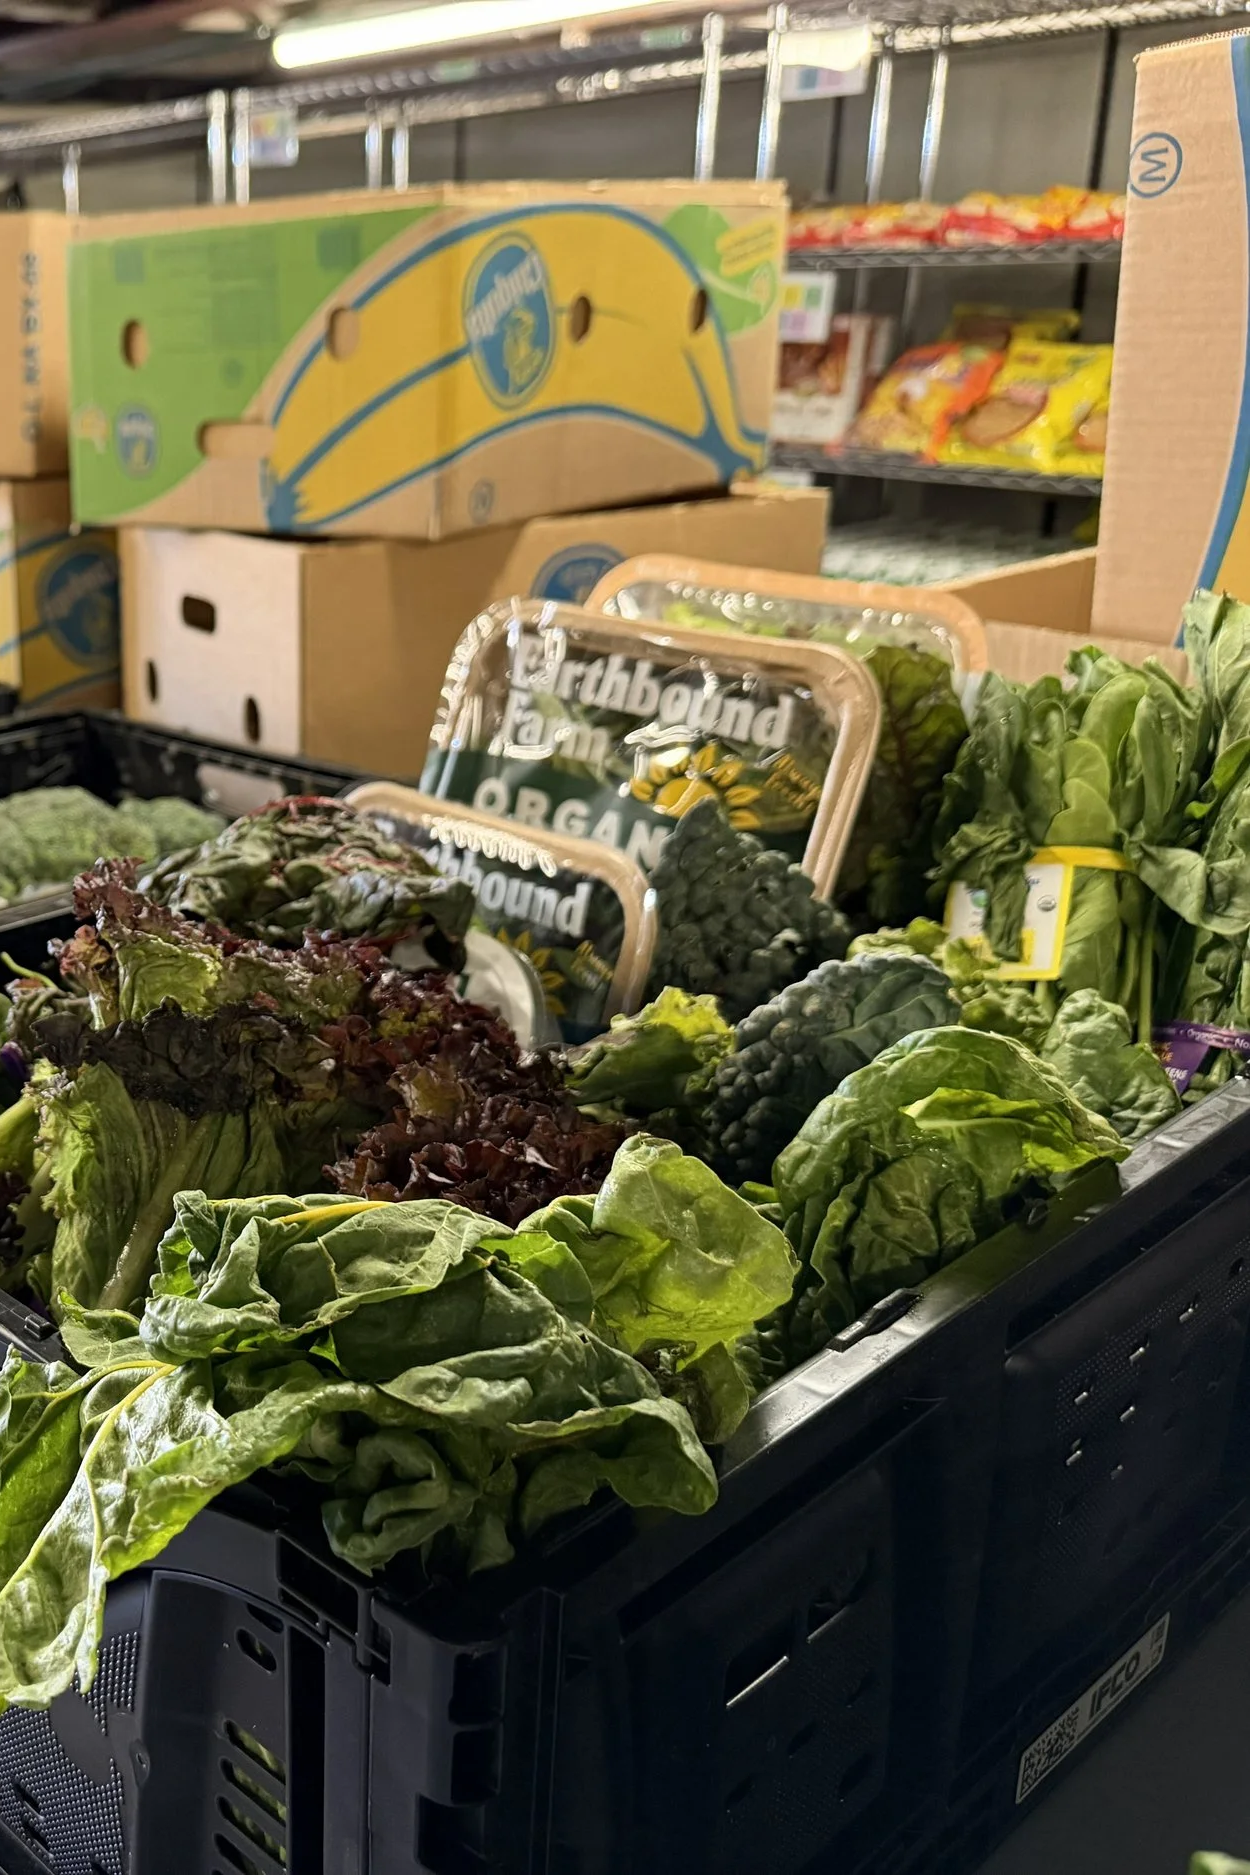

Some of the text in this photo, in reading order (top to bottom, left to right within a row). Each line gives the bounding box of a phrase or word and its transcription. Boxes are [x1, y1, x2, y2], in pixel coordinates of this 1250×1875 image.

[511, 633, 795, 748] Earthbound
[474, 776, 672, 870] ORGAN
[424, 840, 593, 938] hbound
[1089, 1651, 1141, 1720] IFCO
